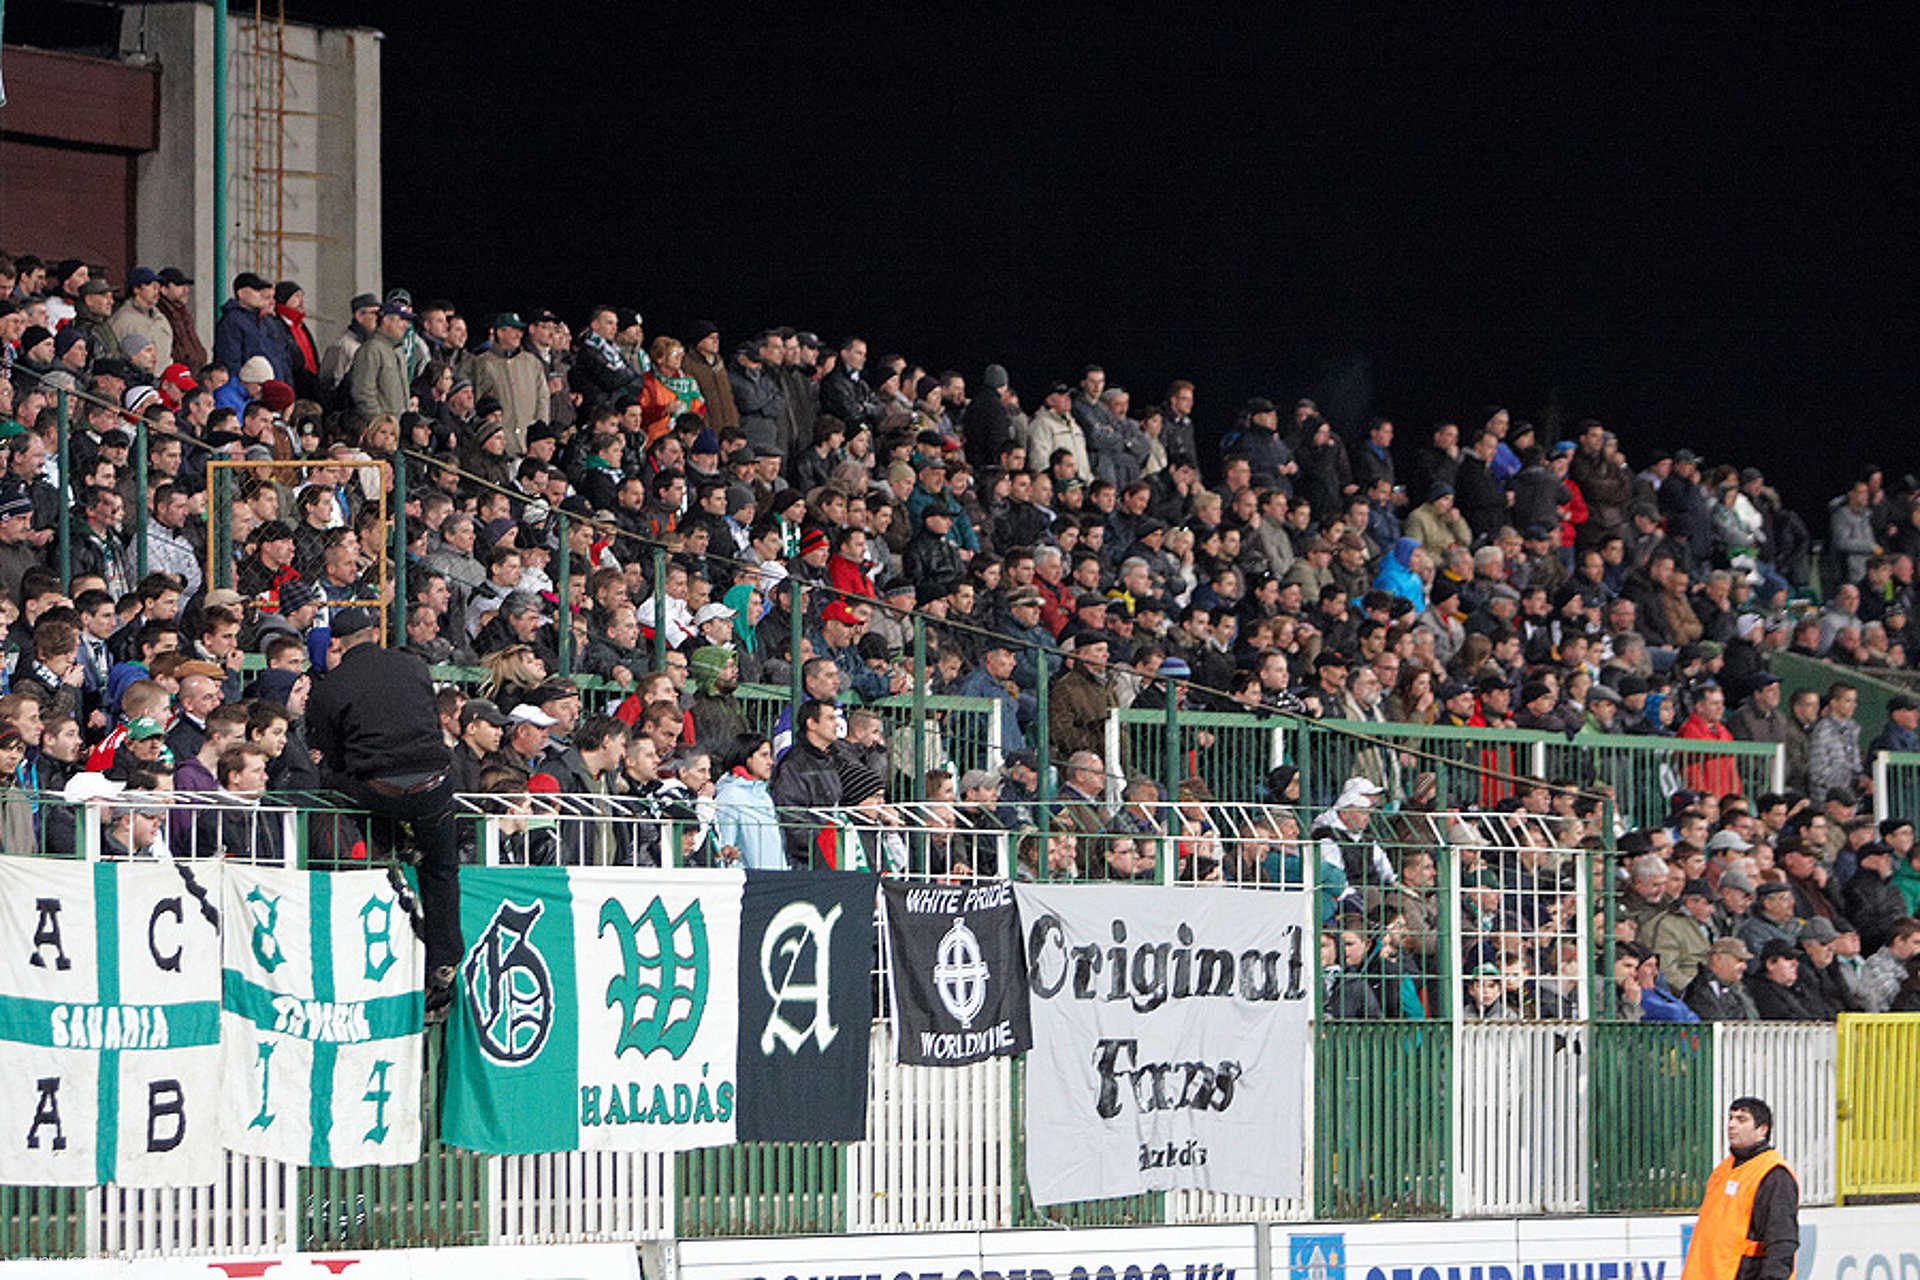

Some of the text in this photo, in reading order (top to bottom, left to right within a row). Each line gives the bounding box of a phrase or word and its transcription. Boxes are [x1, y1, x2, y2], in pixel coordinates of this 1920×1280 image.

[29, 896, 184, 973] A C
[906, 881, 1012, 914] WHITE PRIDE
[760, 901, 844, 1057] A
[1028, 914, 1307, 1013] Original
[27, 1077, 187, 1152] A B
[247, 1040, 279, 1132] 1
[581, 1061, 735, 1126] HALADÁS
